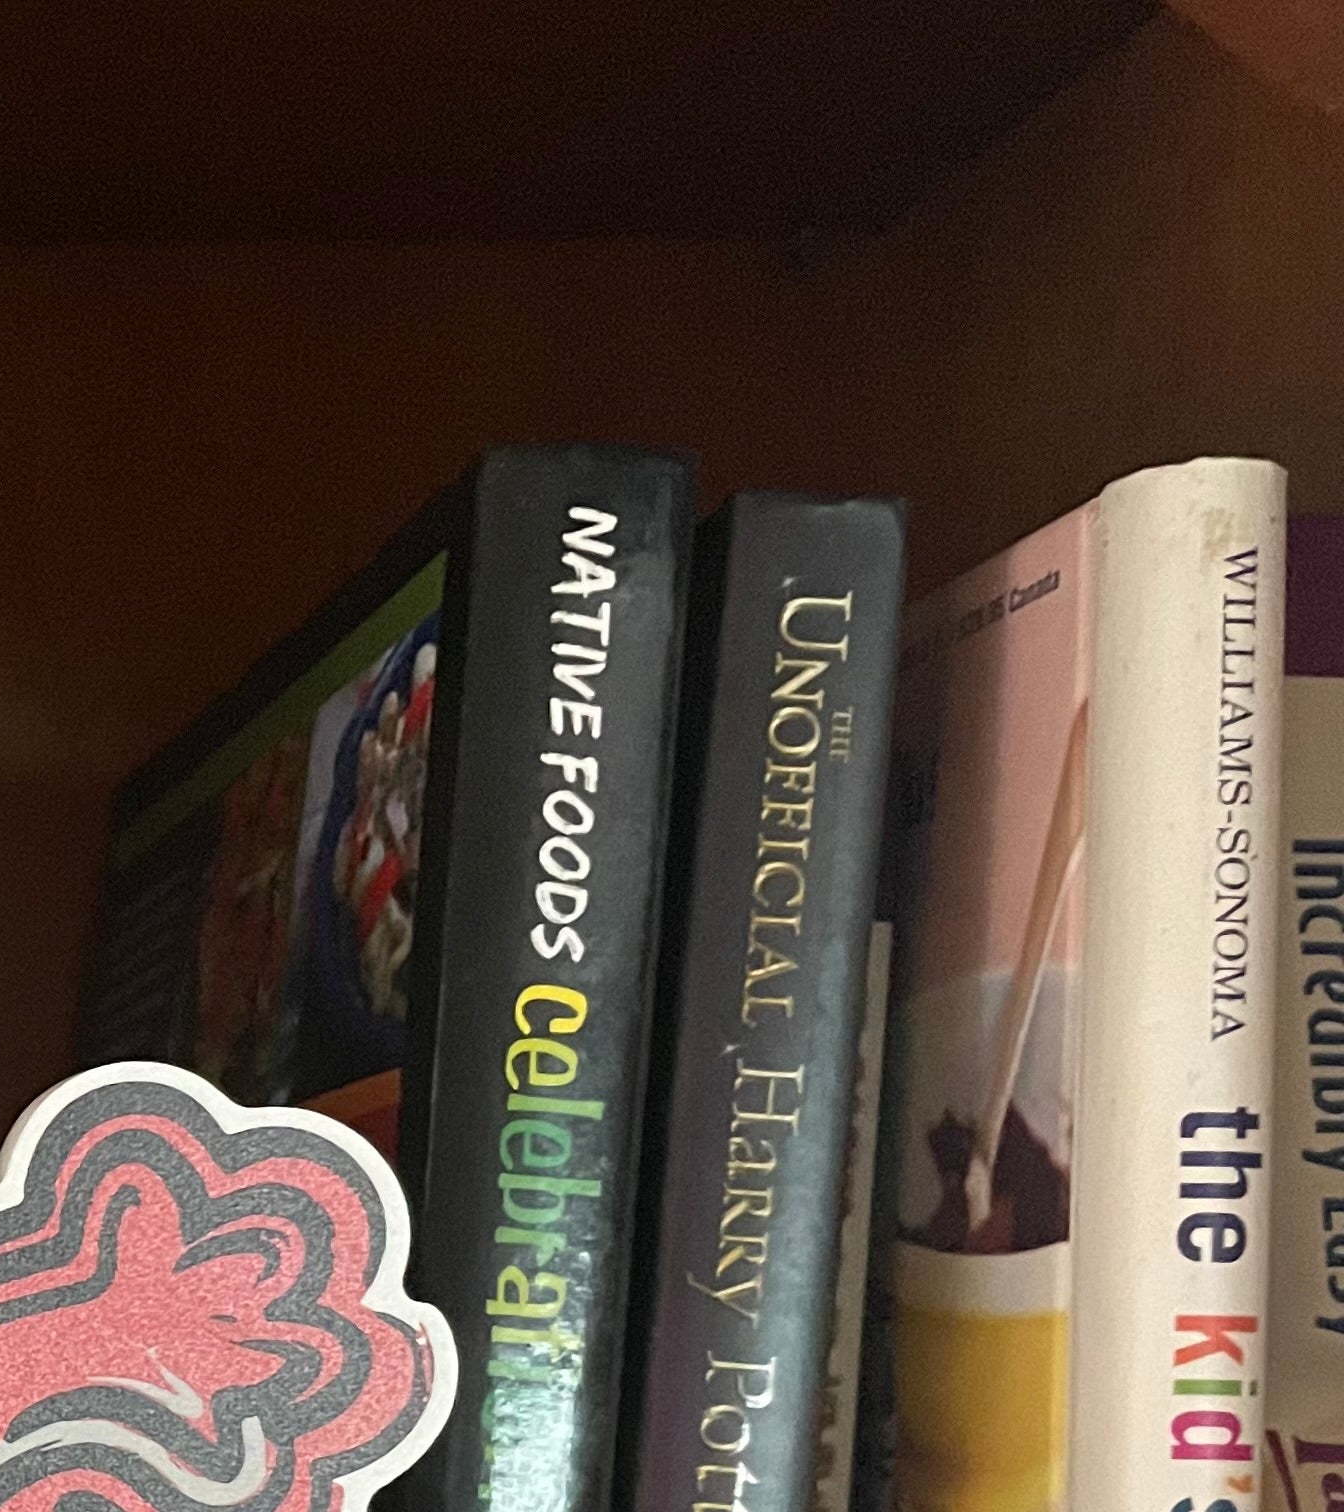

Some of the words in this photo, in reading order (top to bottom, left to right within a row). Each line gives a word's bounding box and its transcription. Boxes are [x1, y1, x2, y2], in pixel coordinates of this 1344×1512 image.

[550, 506, 617, 740] NATIVE
[827, 706, 855, 766] THE
[1210, 546, 1259, 1042] WILLIAMS-SONOMA
[530, 752, 599, 964] FOODS
[478, 983, 606, 1500] celebrati
[1177, 1106, 1263, 1264] the
